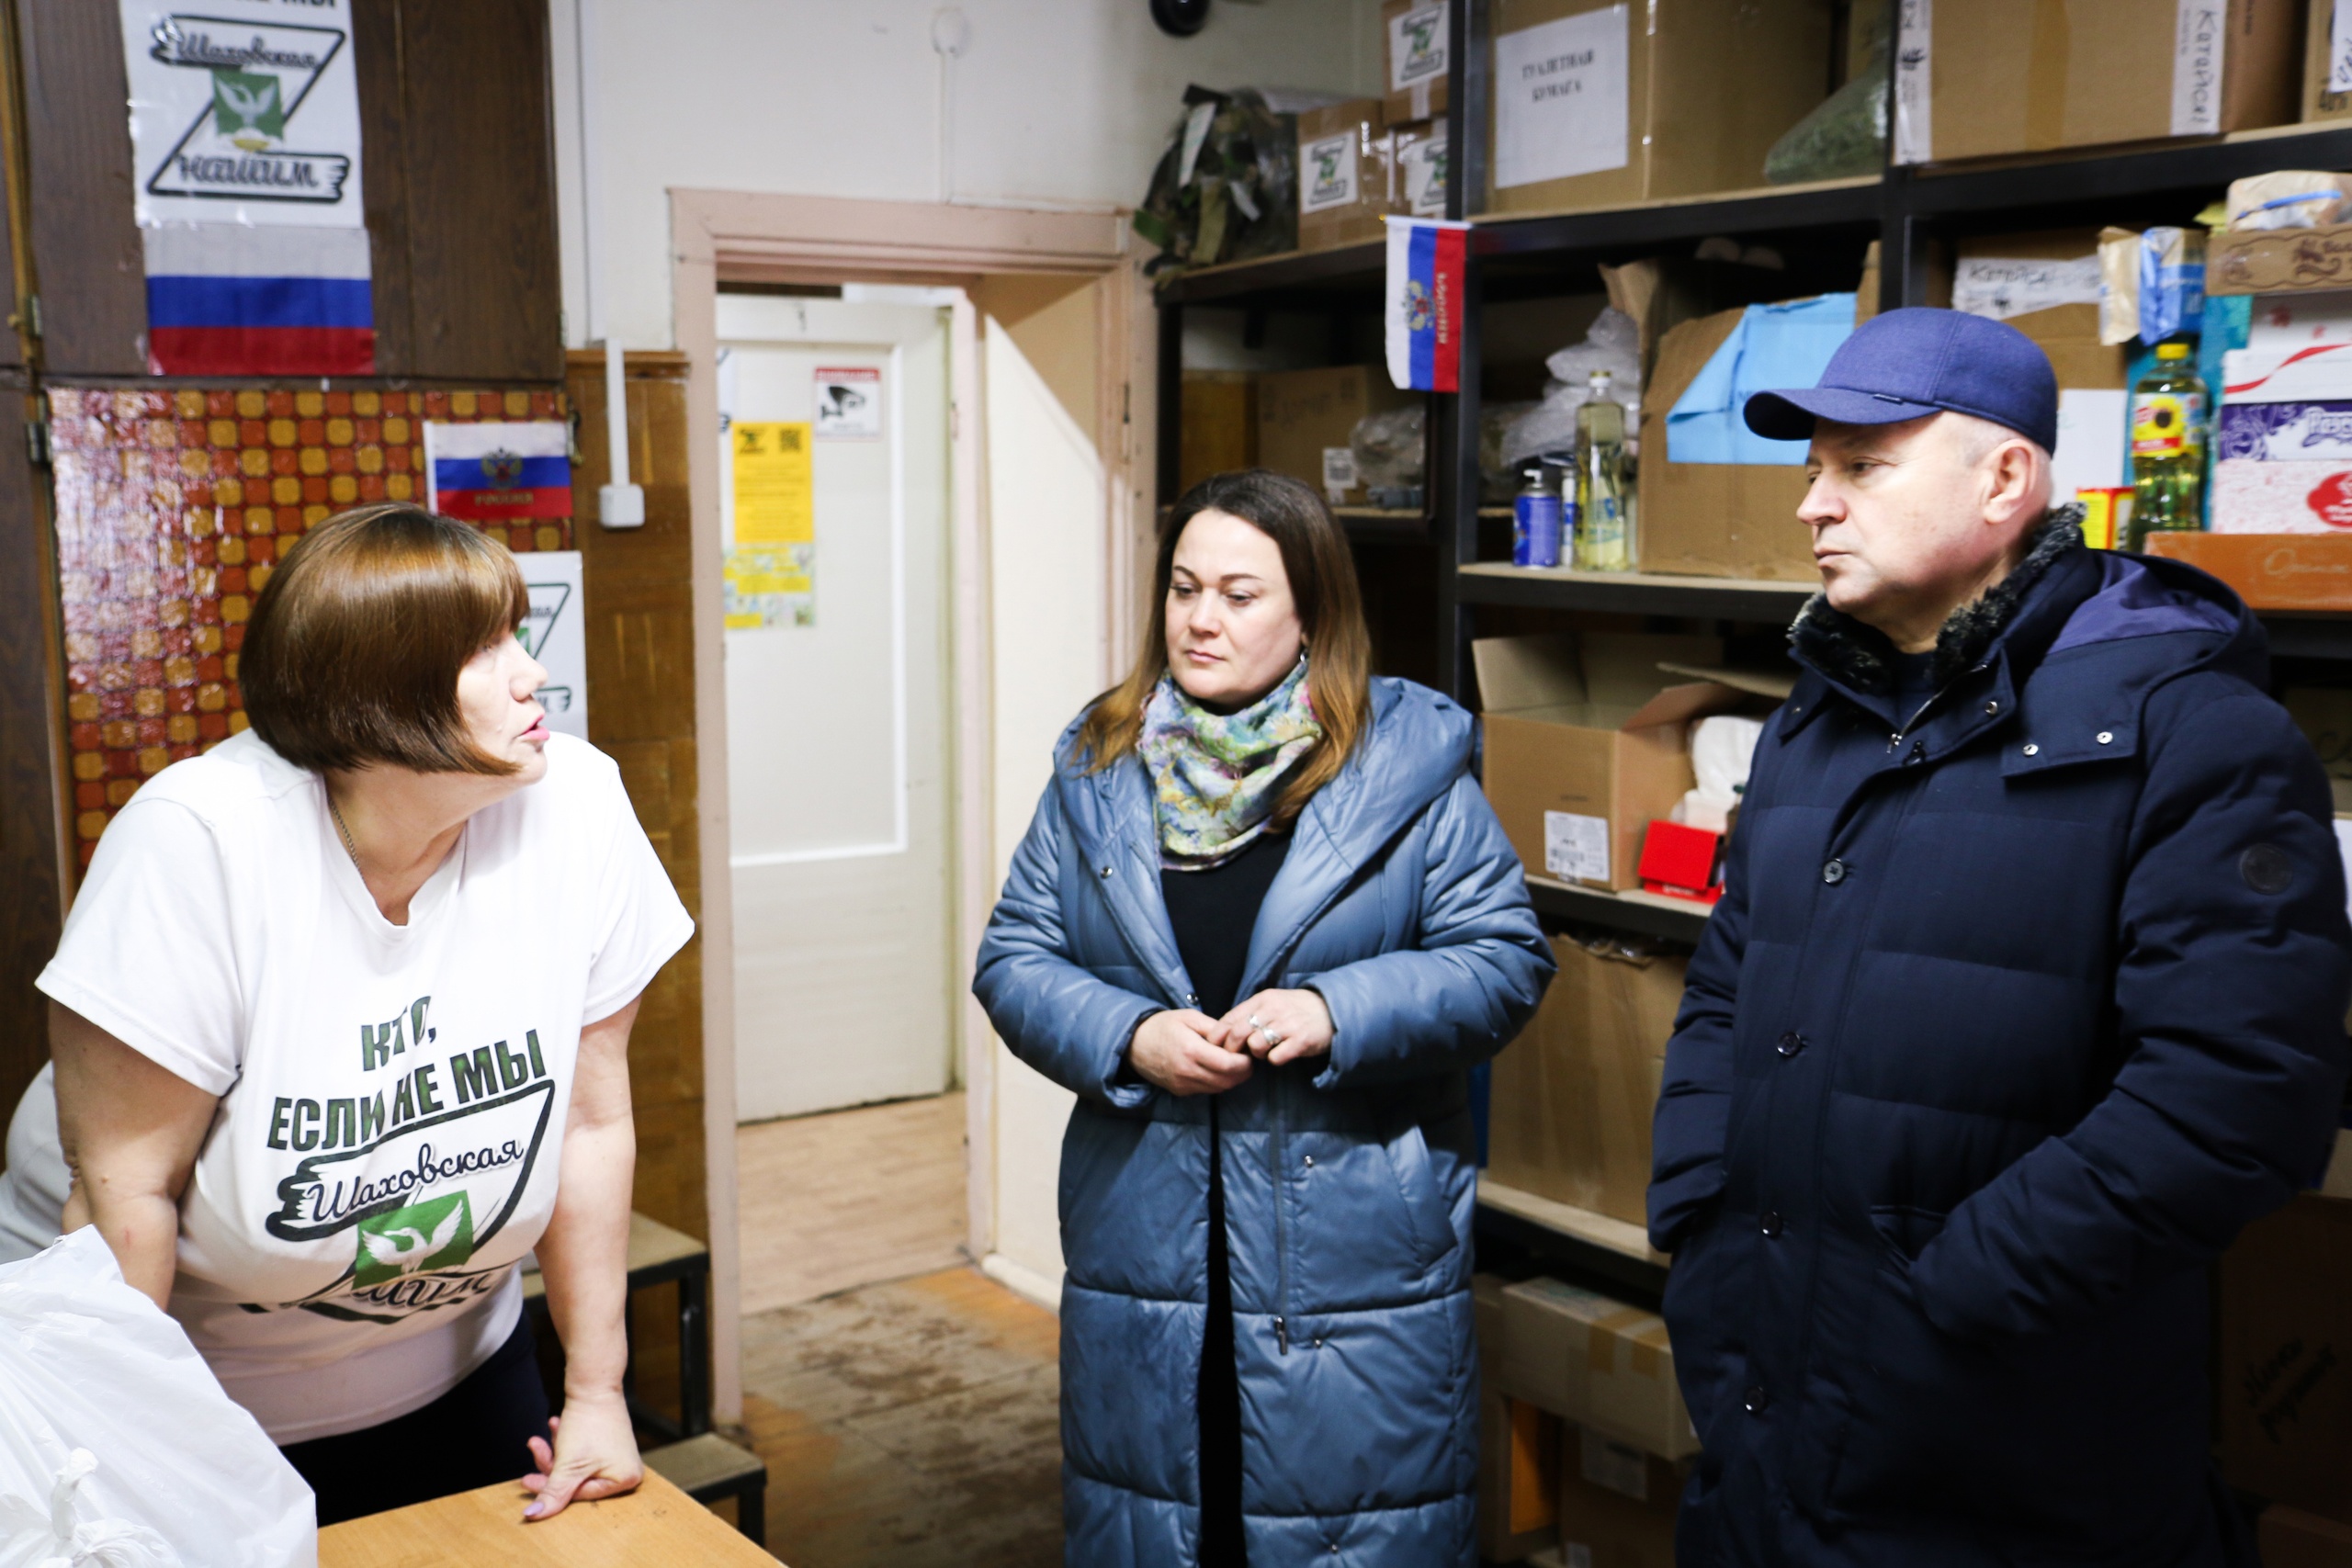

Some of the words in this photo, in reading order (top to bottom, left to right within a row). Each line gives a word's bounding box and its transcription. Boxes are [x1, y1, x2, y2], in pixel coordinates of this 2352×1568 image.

[1521, 49, 1594, 81] ТУАЛЕТНАЯ
[1532, 79, 1581, 101] БУМАГА
[266, 1088, 386, 1152] ЕСЛИ
[392, 1063, 445, 1127] НЕ
[449, 1029, 547, 1104] МЫ
[306, 1142, 525, 1223] Шаховская
